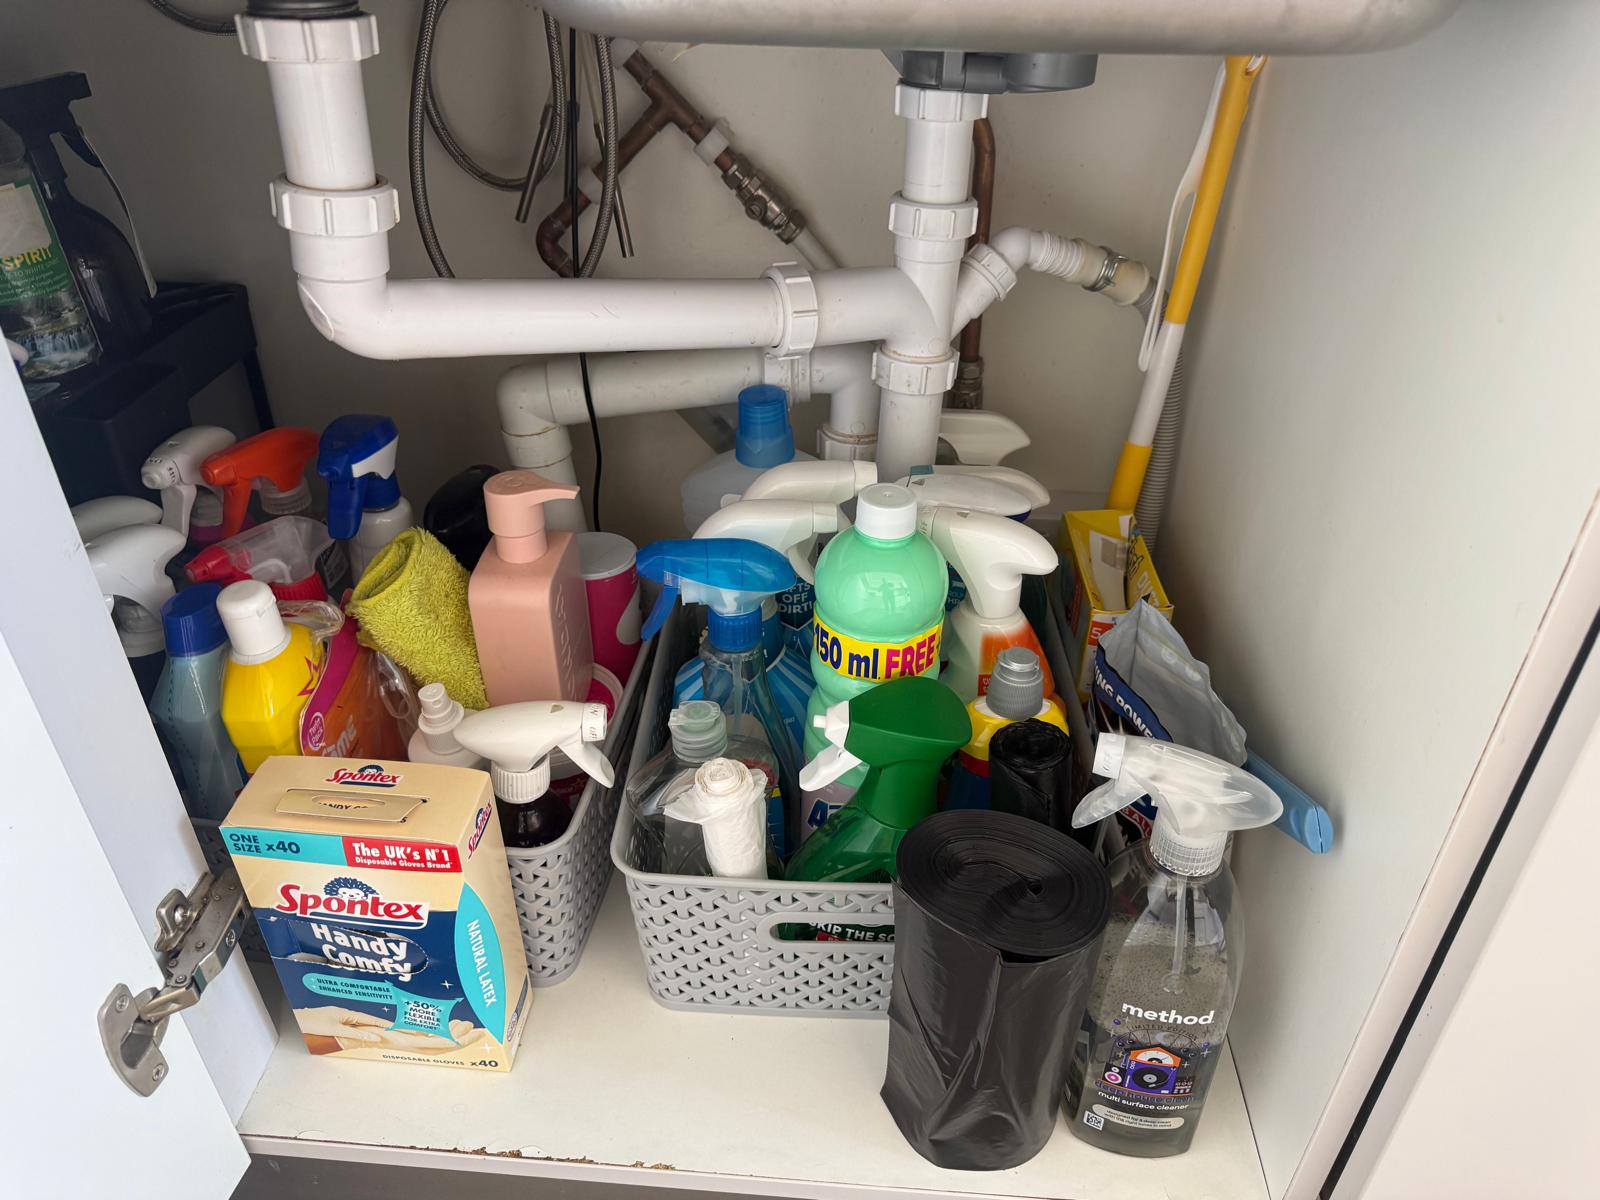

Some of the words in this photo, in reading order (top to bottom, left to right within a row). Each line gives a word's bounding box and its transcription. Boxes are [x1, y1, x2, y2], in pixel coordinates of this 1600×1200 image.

[782, 592, 809, 604] OFF
[814, 622, 842, 670] 150
[884, 632, 937, 679] FREE
[1116, 694, 1156, 740] POWE
[325, 768, 400, 784] Spontex
[229, 833, 260, 844] ONE
[233, 843, 262, 853] SIZE
[265, 840, 301, 854] x40
[352, 842, 380, 857] The
[384, 845, 421, 860] UK's
[355, 856, 397, 866] Disposable
[398, 860, 425, 868] Gloves
[275, 884, 425, 920] Spontex
[310, 922, 407, 961] Handy
[846, 928, 875, 942] THE
[321, 944, 412, 982] Comfy
[467, 919, 488, 974] NATURAL
[478, 971, 497, 1008] LATEX
[317, 978, 338, 986] ULTRA
[340, 982, 390, 993] COMFORTABLE
[318, 985, 353, 995] ENHANCED
[354, 990, 393, 1000] SENSITIVITY
[404, 1000, 442, 1013] +50%
[409, 1006, 436, 1016] MORE
[1122, 1003, 1215, 1025] method
[404, 1011, 441, 1022] FLEXIBLE
[382, 1054, 431, 1063] DISPOSABLE
[433, 1058, 465, 1066] GLOVES
[1098, 1091, 1121, 1102] multi
[1121, 1099, 1155, 1110] surface
